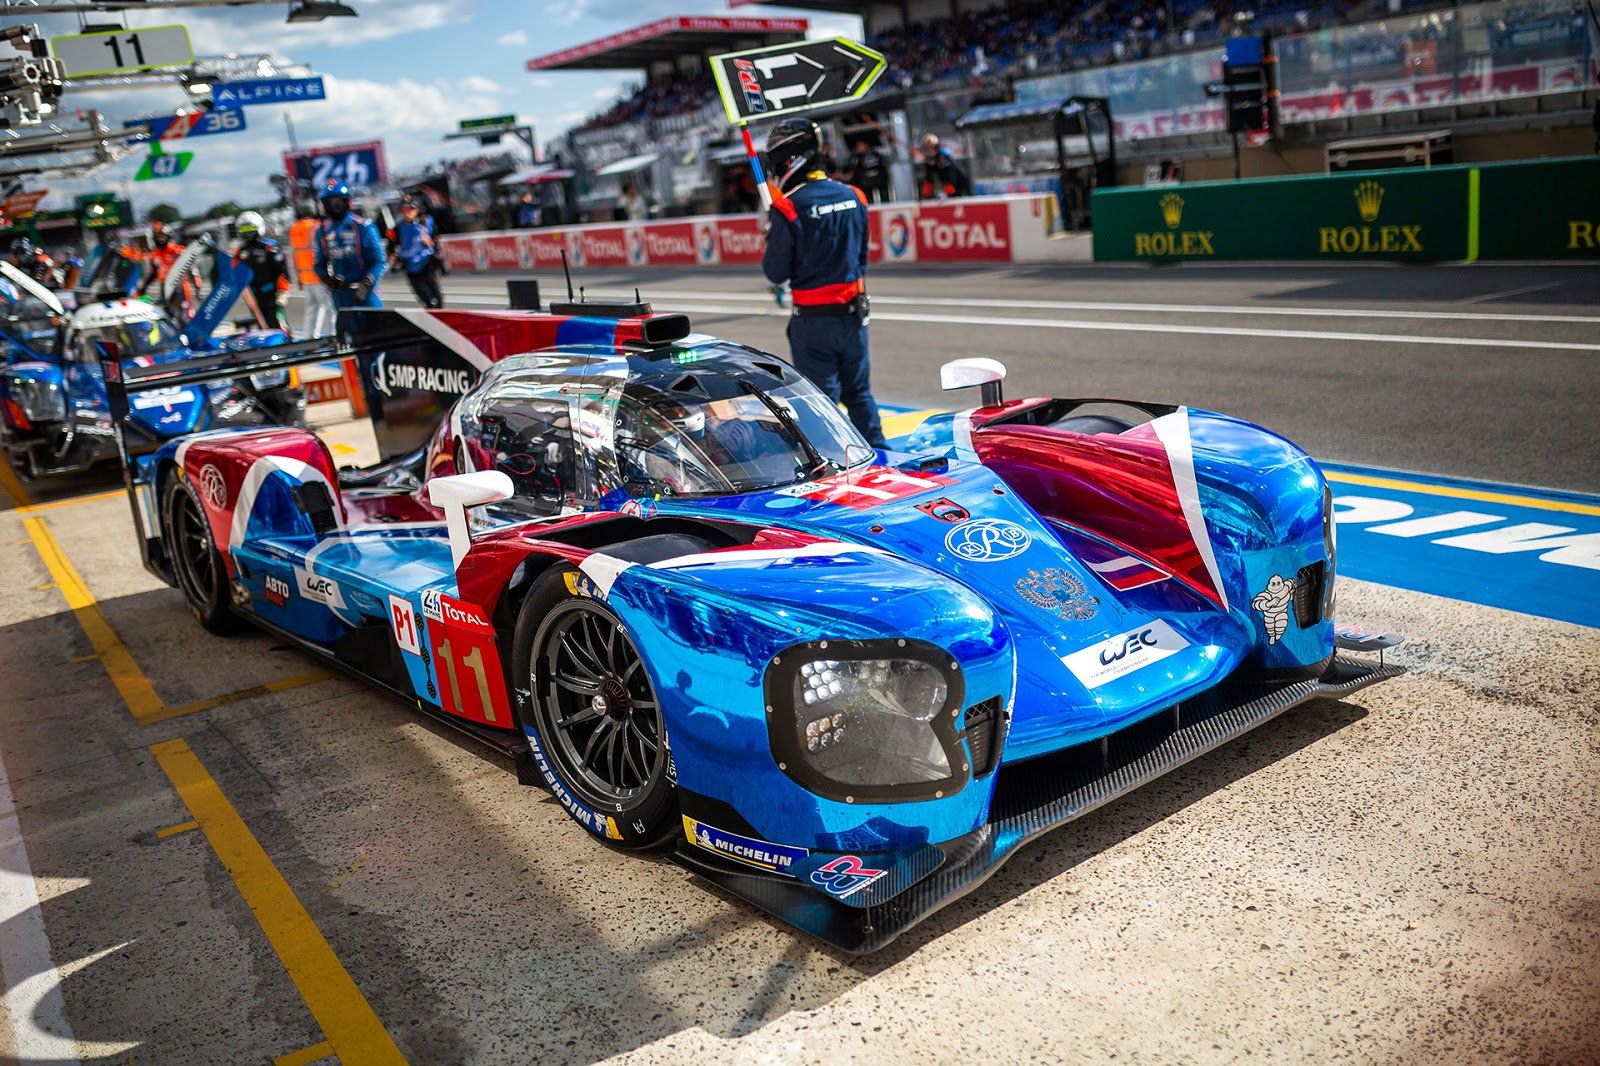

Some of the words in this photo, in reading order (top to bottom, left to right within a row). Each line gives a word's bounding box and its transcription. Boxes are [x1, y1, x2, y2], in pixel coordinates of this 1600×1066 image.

[104, 34, 146, 67] 11
[218, 81, 322, 101] ALPINE
[753, 53, 808, 110] 11
[206, 109, 240, 131] 36
[153, 157, 176, 176] 47
[584, 235, 624, 258] TOTAL
[647, 229, 694, 256] TOTAL
[917, 218, 1007, 250] TOTAL
[1135, 230, 1216, 256] ROLEX
[1319, 224, 1424, 252] ROLEX
[388, 363, 416, 389] SMP
[417, 366, 469, 395] RACING
[830, 472, 939, 499] 11
[307, 577, 333, 596] WEC
[423, 590, 441, 613] 24h
[442, 602, 489, 627] TOTAL
[392, 604, 415, 646] P1
[1099, 628, 1158, 666] WEC
[437, 638, 497, 722] 11
[526, 735, 592, 826] MICHELIN
[715, 838, 793, 867] MICHELIN
